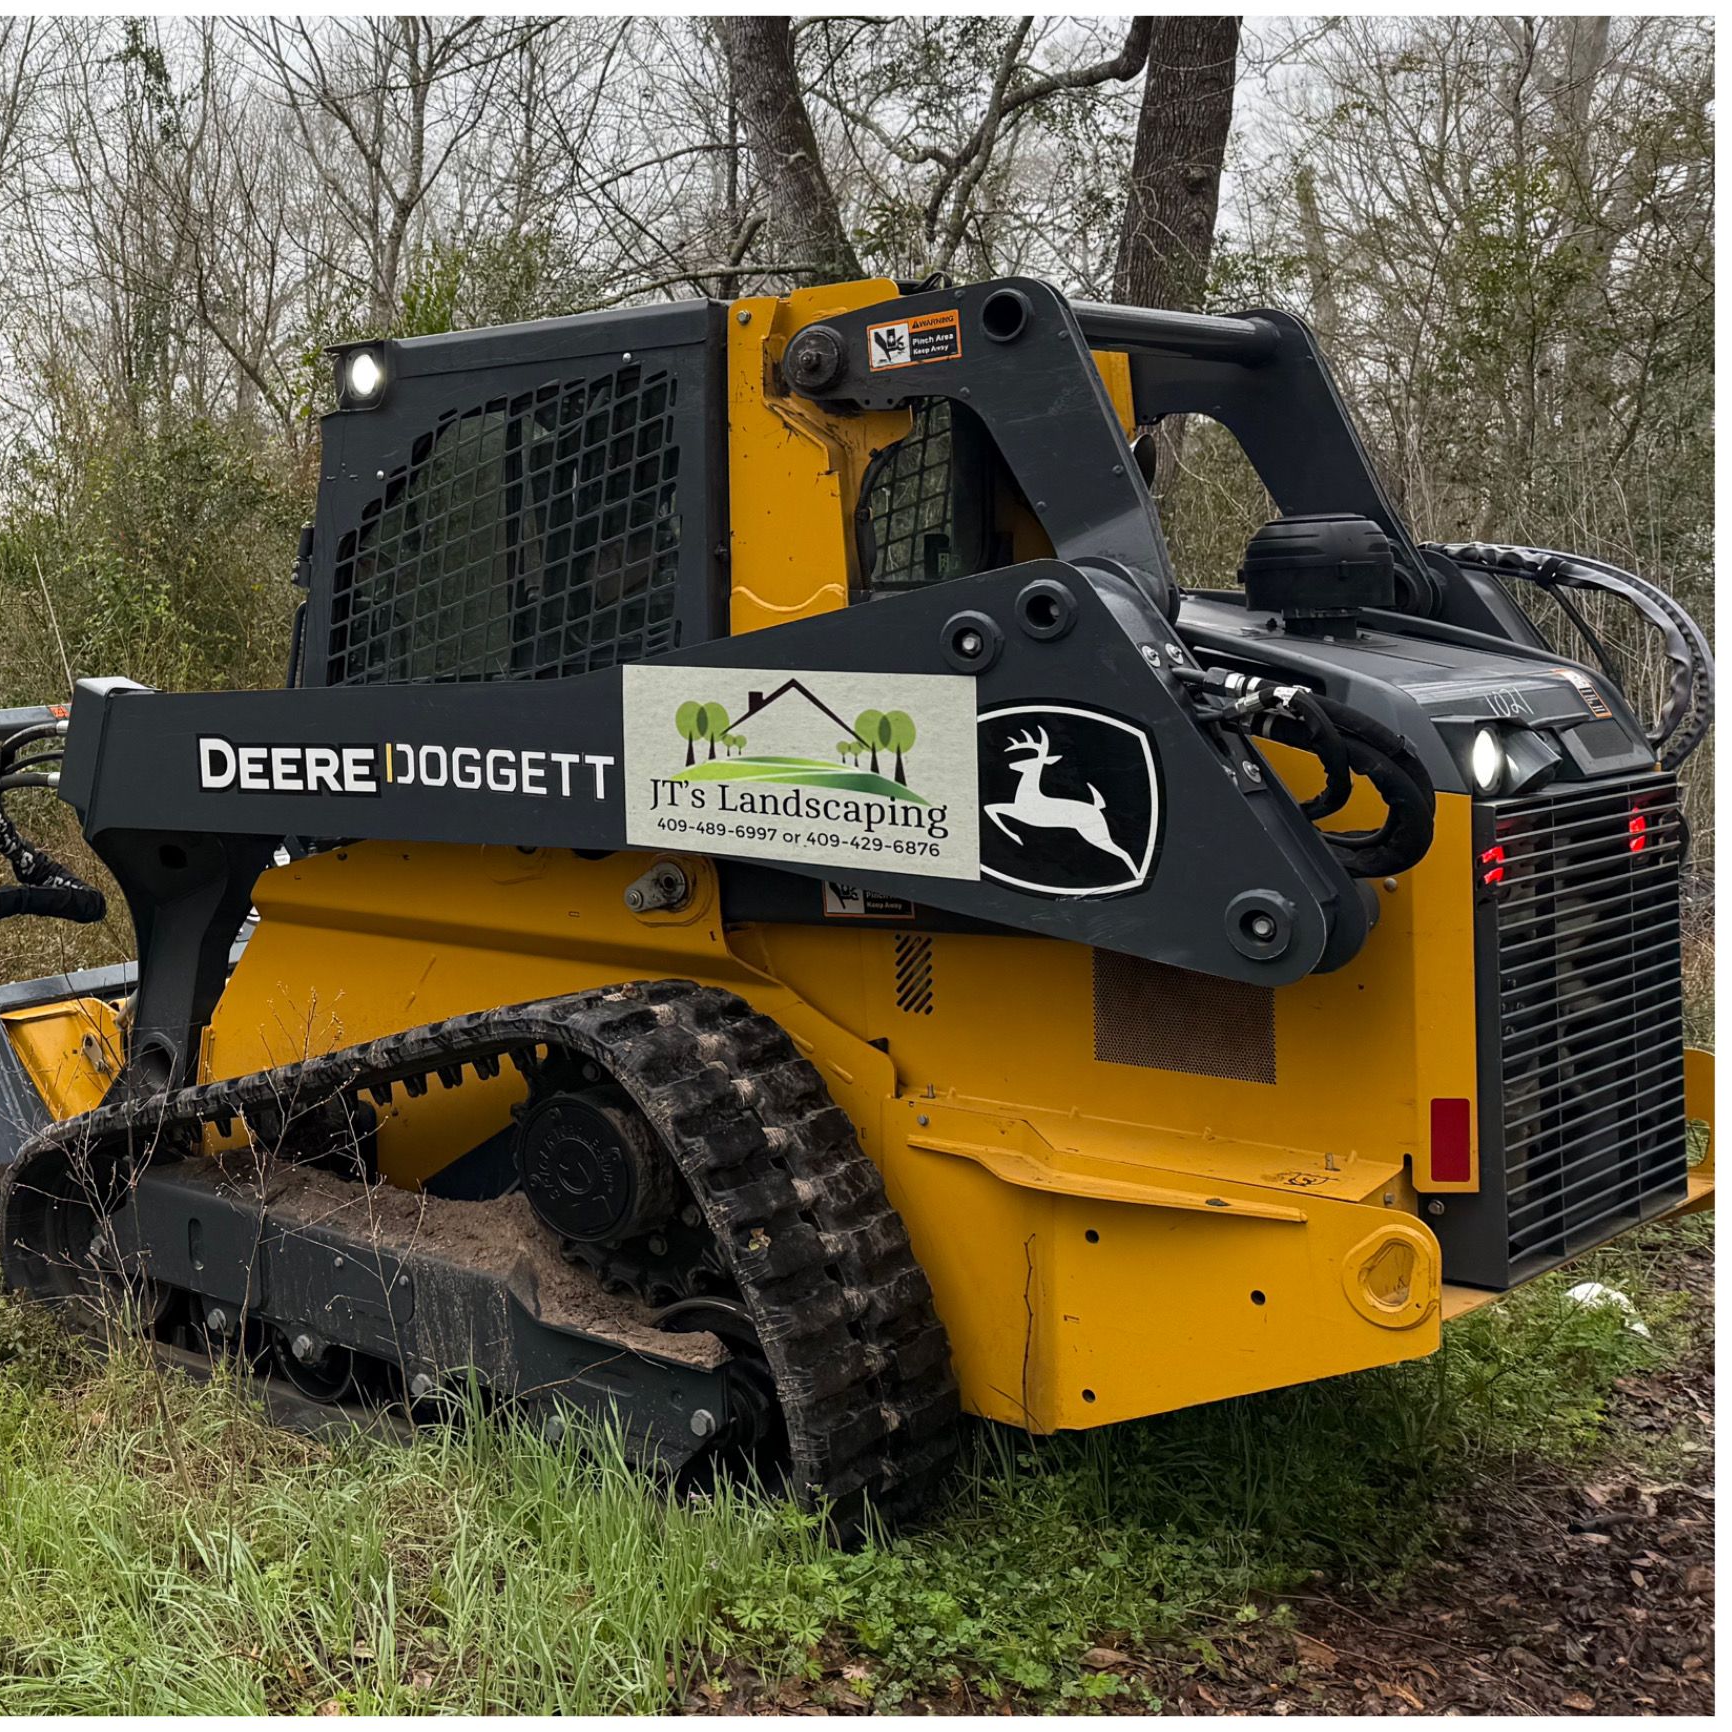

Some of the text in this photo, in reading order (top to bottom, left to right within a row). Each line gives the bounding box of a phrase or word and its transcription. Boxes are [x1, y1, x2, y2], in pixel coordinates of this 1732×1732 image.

[912, 332, 954, 346] Pinch Area
[913, 344, 949, 356] Keep Away
[199, 737, 377, 792] DEERE
[649, 778, 950, 839] JT's Landscaping
[657, 817, 941, 858] 409-489-6997 or 409-429-6876
